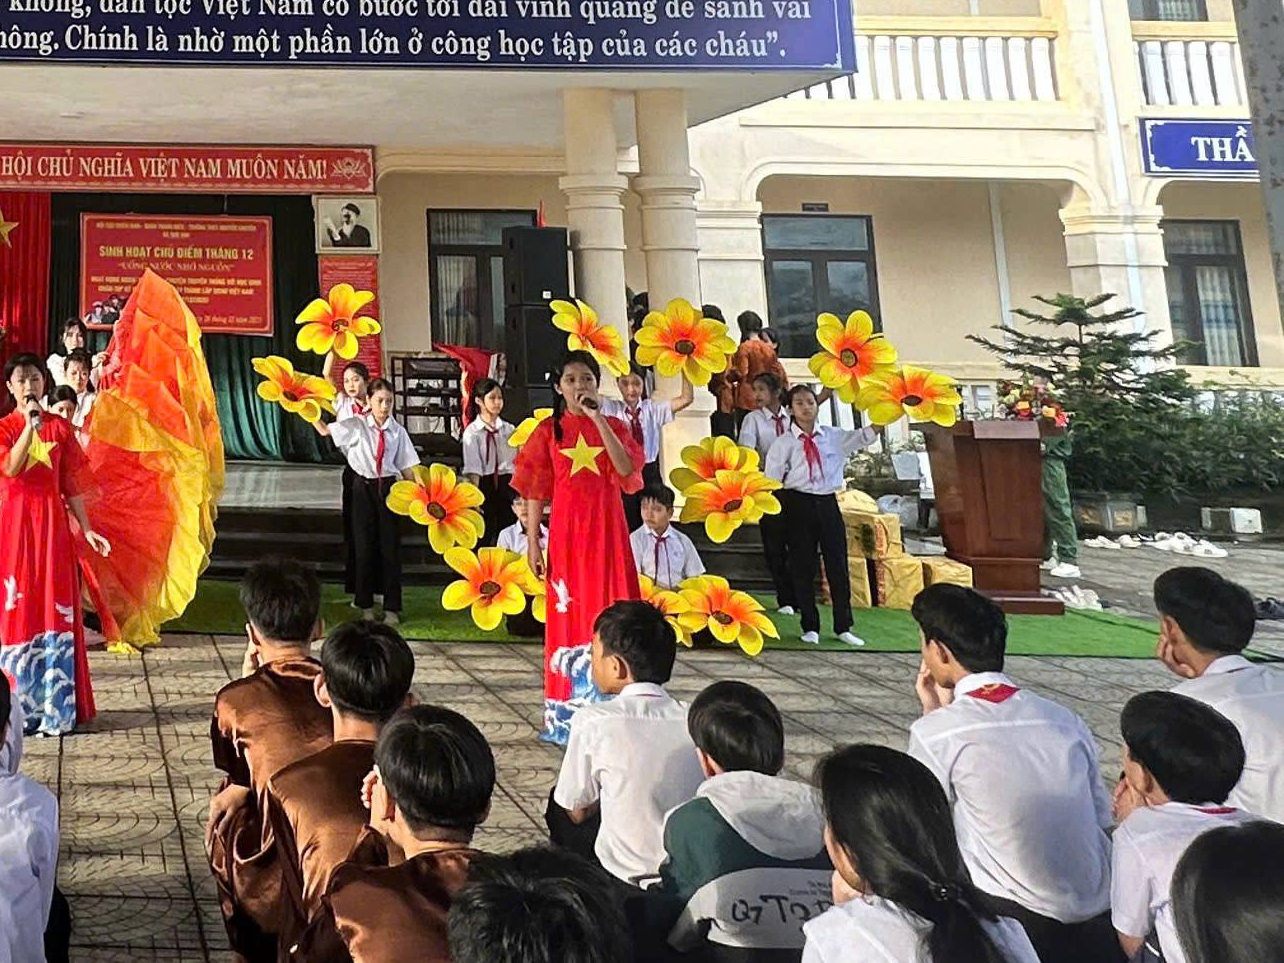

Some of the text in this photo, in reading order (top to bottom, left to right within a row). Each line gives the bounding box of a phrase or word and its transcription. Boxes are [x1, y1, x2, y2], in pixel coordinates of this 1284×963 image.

[580, 0, 657, 24] quang
[65, 25, 138, 50] Chính
[147, 26, 168, 51] là
[178, 27, 224, 52] nhờ
[233, 29, 280, 58] một
[289, 24, 351, 59] phần
[360, 29, 399, 54] lớn
[408, 28, 422, 54] ở
[432, 30, 491, 61] công
[499, 30, 543, 61] học
[552, 32, 593, 62] tập
[602, 30, 647, 56] của
[655, 31, 697, 56] các
[706, 30, 788, 60] cháu”.
[1191, 125, 1255, 162] THẦ
[1, 151, 32, 178] HỘI
[38, 151, 73, 176] CHỦ
[79, 152, 134, 177] NGHĨA
[139, 153, 179, 177] VIỆT
[184, 156, 221, 179] NAM
[227, 154, 278, 179] MUÔN
[284, 155, 326, 179] NĂM!
[99, 245, 124, 257] SINH
[205, 246, 239, 260] THÁNG
[242, 248, 254, 260] 12
